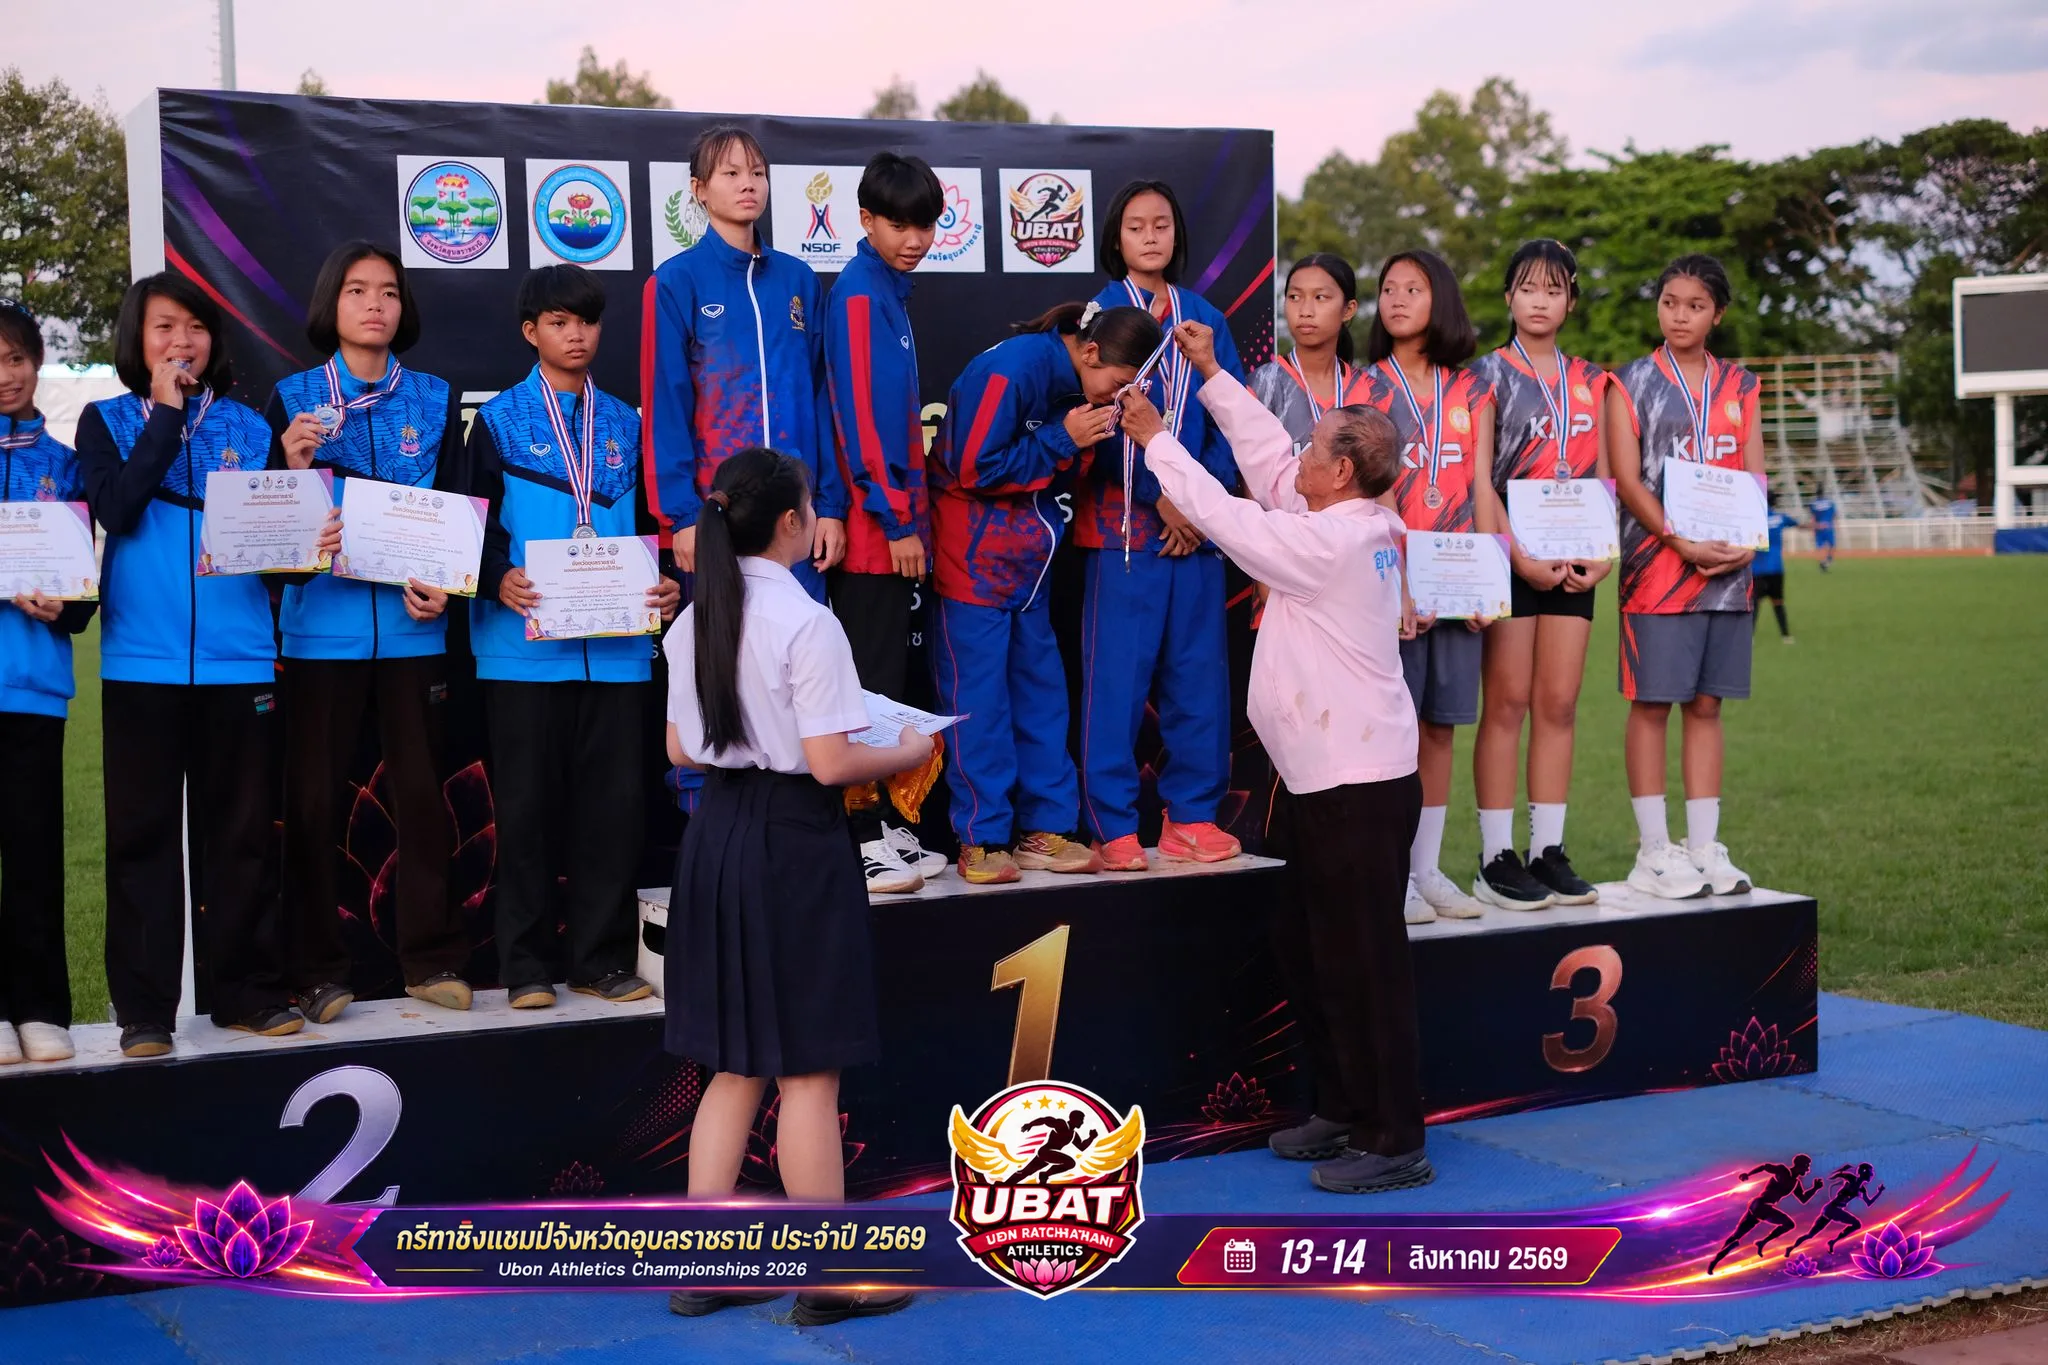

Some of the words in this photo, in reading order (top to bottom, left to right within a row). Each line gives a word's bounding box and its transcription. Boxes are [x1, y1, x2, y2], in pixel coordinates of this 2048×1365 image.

[801, 243, 841, 252] NSDF
[1016, 221, 1079, 240] UBAT
[1529, 413, 1593, 440] KP
[991, 924, 1070, 1088] 1
[1542, 944, 1623, 1073] 3
[279, 1065, 402, 1207] 2
